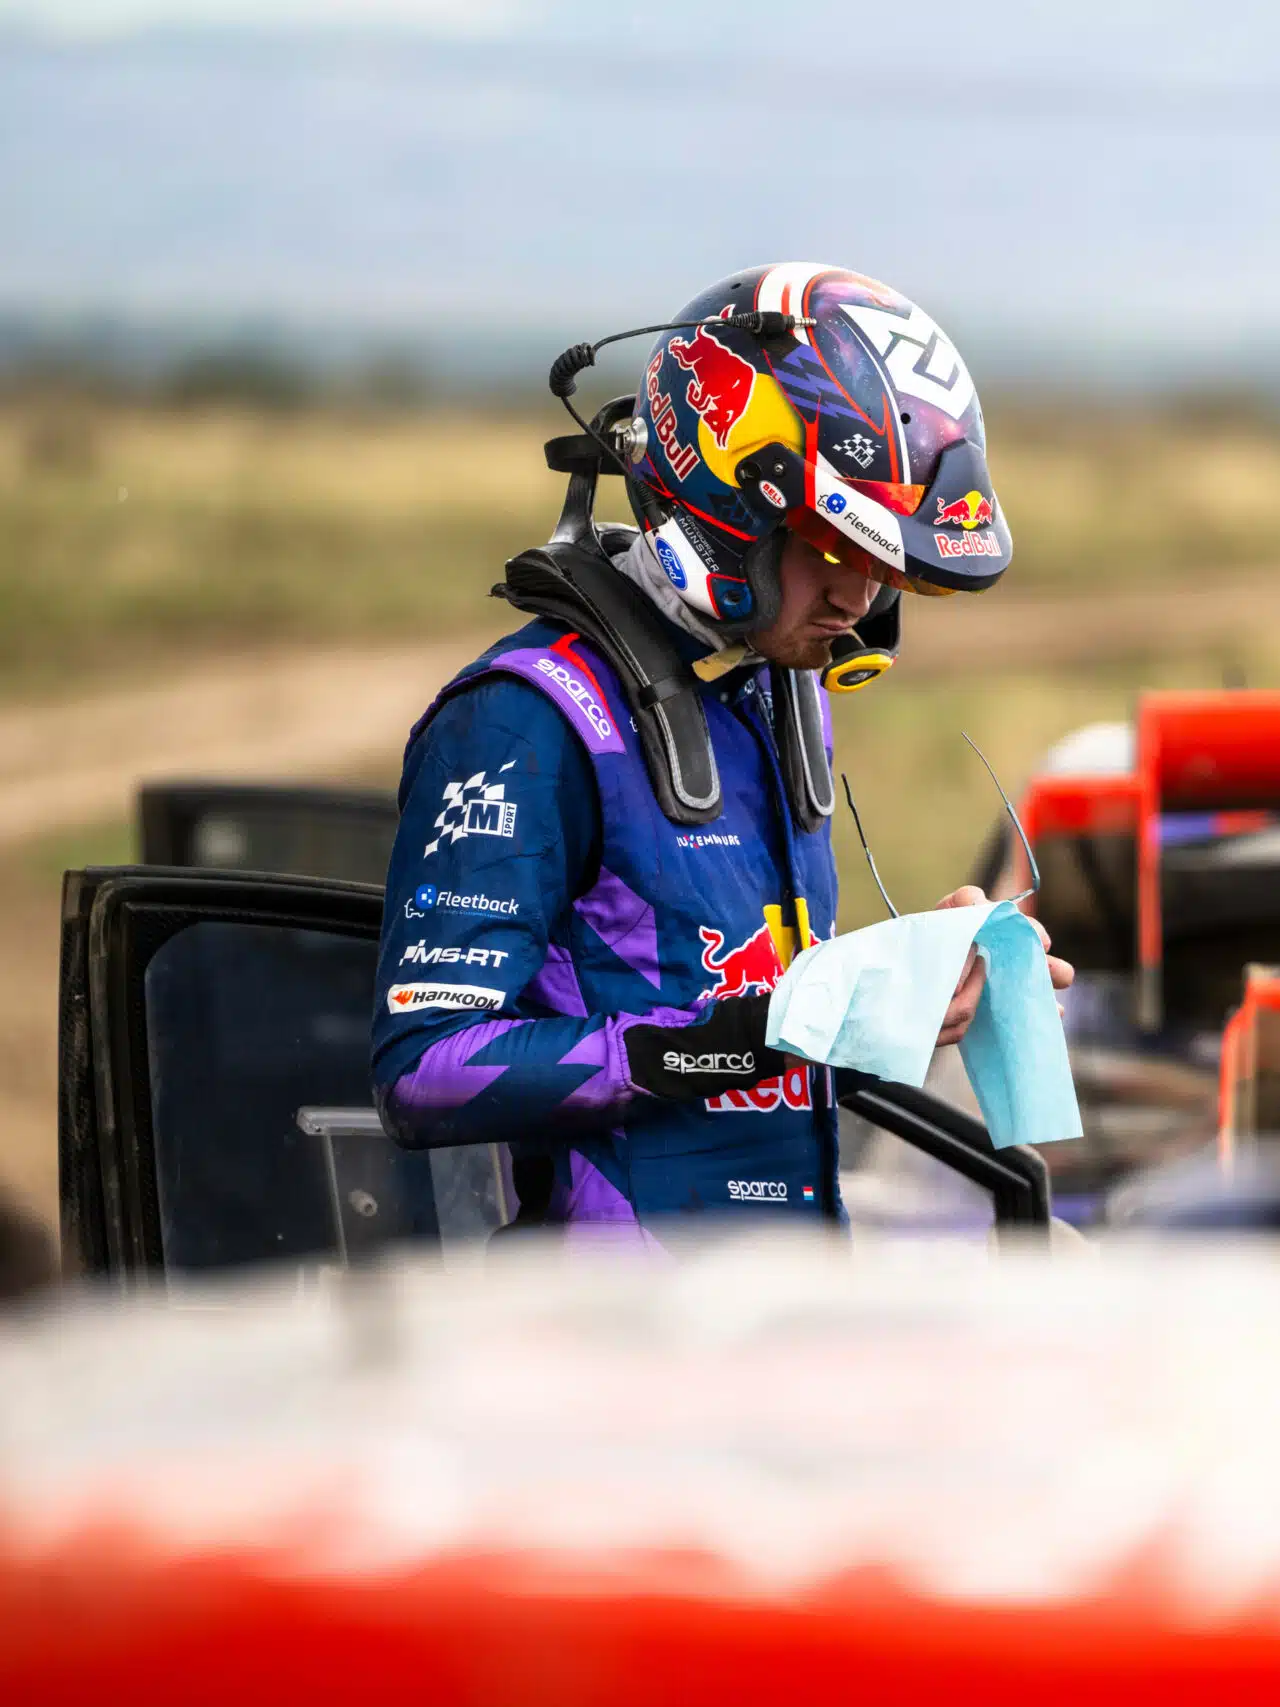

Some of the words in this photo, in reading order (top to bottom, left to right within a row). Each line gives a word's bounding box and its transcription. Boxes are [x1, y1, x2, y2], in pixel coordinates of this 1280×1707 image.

[762, 483, 782, 505] BELL
[678, 517, 720, 573] MUNSTER
[844, 512, 901, 555] Fleetback
[658, 547, 682, 582] Ford
[534, 659, 611, 739] sparco
[467, 802, 501, 832] M
[503, 805, 516, 835] SPORT
[436, 891, 520, 915] Fleetback
[411, 946, 509, 968] MS-RT
[663, 1051, 756, 1074] sparco
[727, 1180, 788, 1201] sparco
